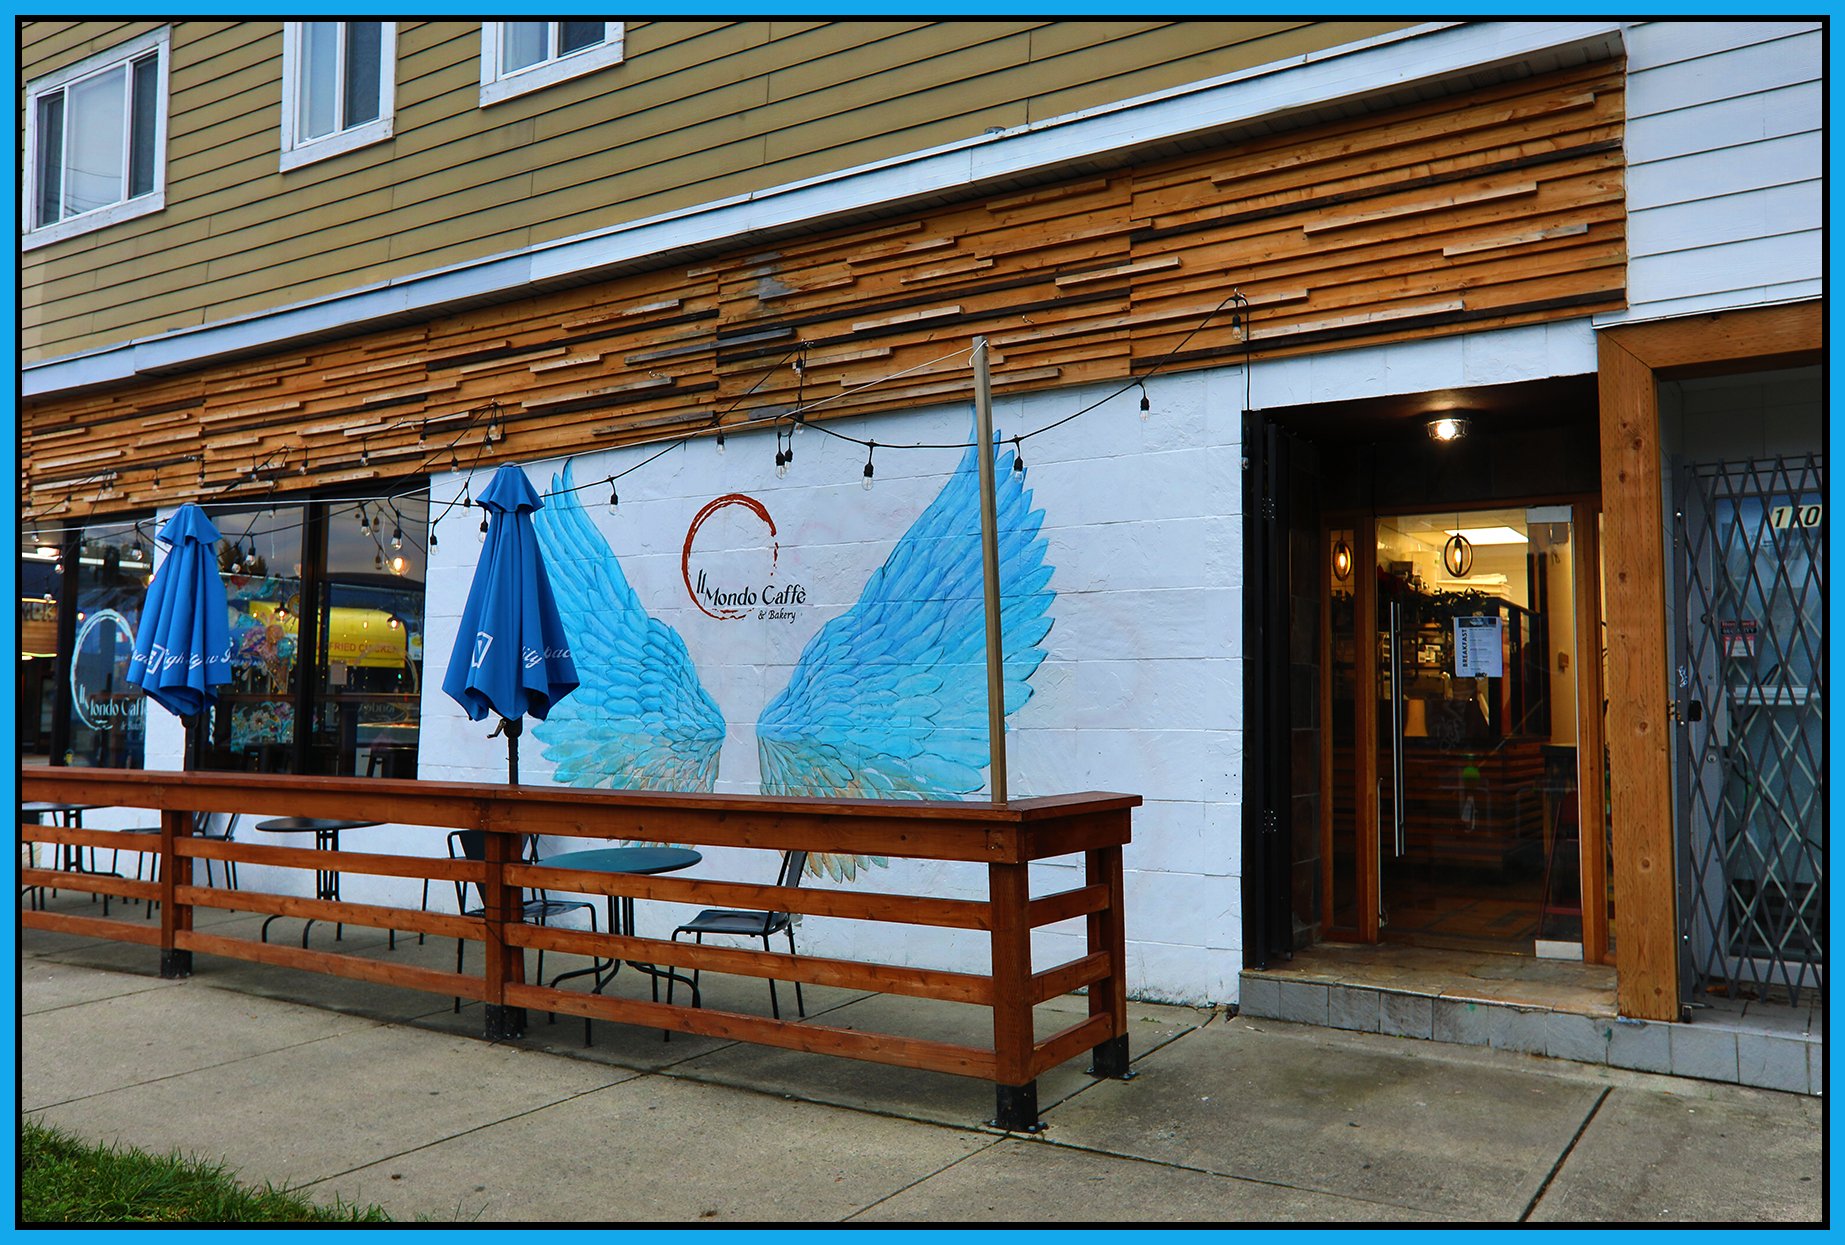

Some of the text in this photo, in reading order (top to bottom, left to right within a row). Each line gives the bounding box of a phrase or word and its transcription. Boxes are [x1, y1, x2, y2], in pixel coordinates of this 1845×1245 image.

[1775, 505, 1821, 528] 10
[704, 583, 807, 606] Mondo Caffè
[757, 607, 796, 624] & Bakery
[329, 642, 357, 653] FRIED
[84, 698, 119, 716] Mondo
